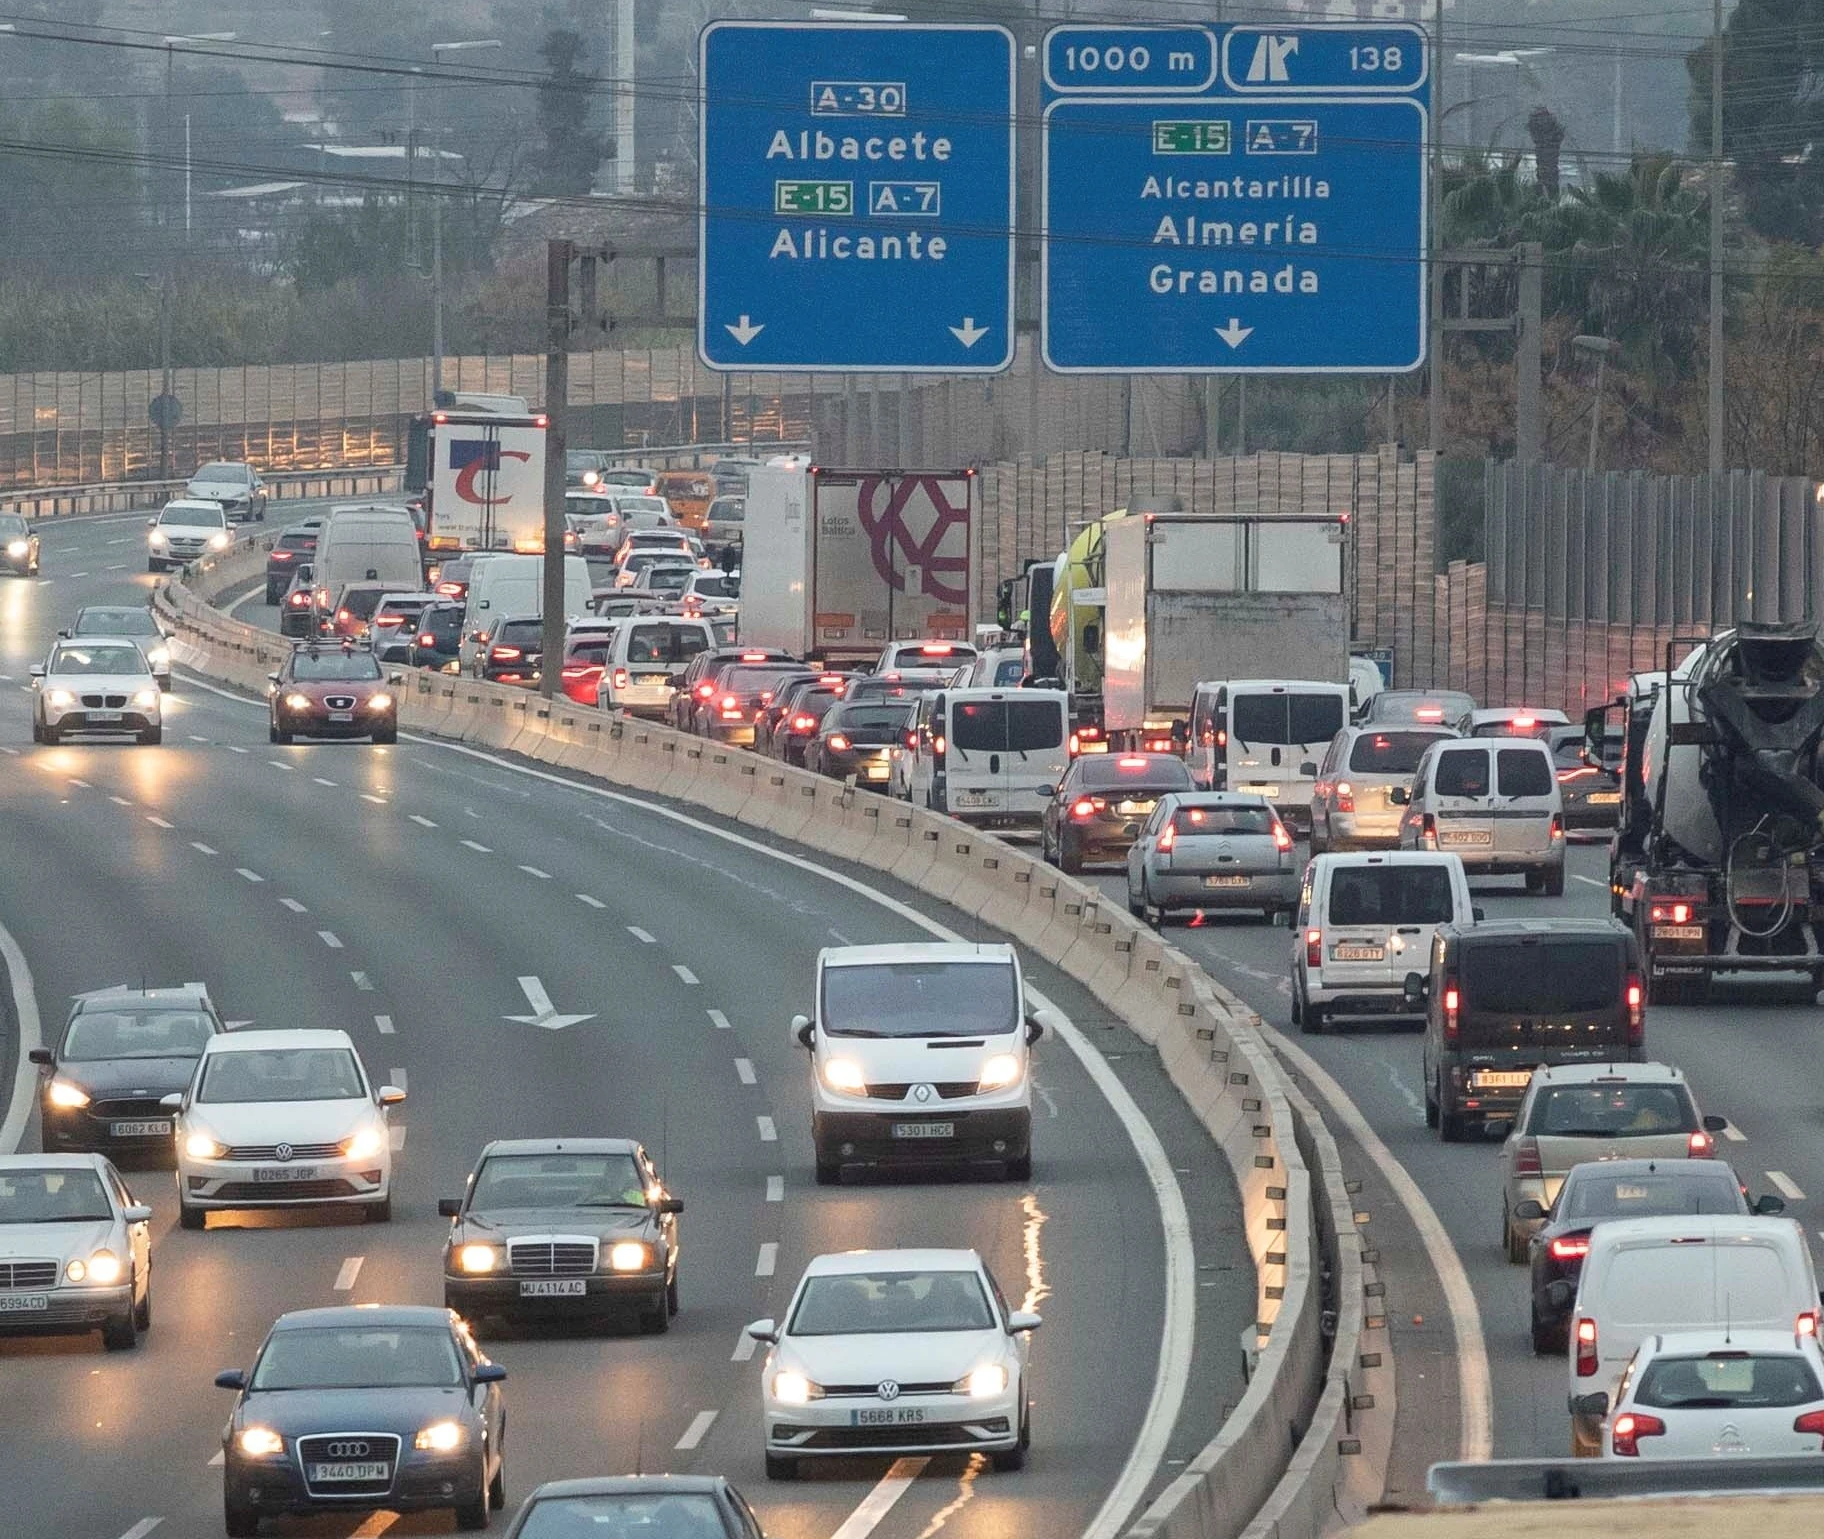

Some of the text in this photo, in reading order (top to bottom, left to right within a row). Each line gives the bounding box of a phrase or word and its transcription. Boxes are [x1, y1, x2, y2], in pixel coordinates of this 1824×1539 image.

[1066, 46, 1196, 71] 1000 m
[1349, 46, 1403, 71] 138
[817, 87, 901, 113] A-30
[766, 130, 952, 161] Albacete
[1157, 124, 1314, 151] E-15 A-7
[779, 186, 937, 211] E-15 A-7
[1141, 175, 1331, 200] Alcantarilla
[1153, 215, 1319, 245] Almería
[770, 228, 948, 261] Alicante
[1149, 265, 1320, 294] Granada
